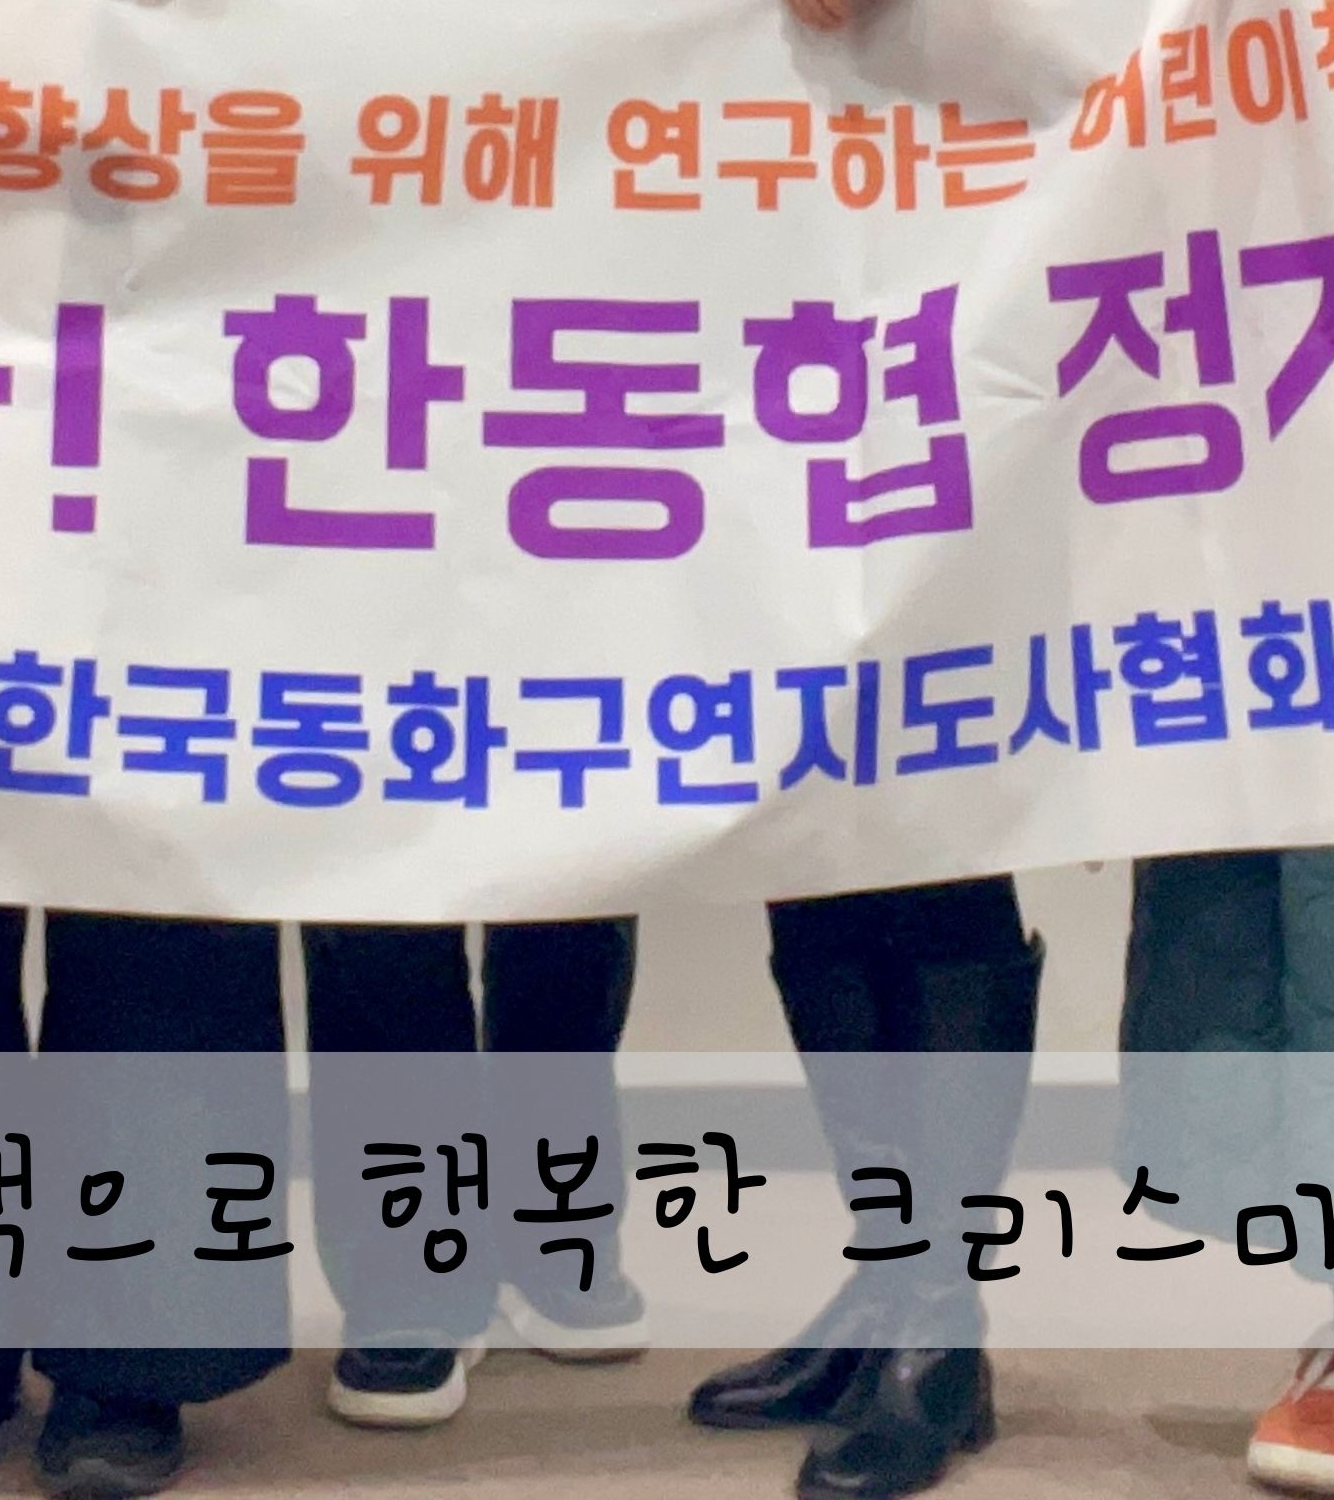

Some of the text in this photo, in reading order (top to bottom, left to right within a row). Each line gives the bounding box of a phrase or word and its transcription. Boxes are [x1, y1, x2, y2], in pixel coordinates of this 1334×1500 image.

[351, 93, 559, 209] 위해
[606, 99, 1037, 212] 연구하는
[223, 293, 974, 561] 한동협
